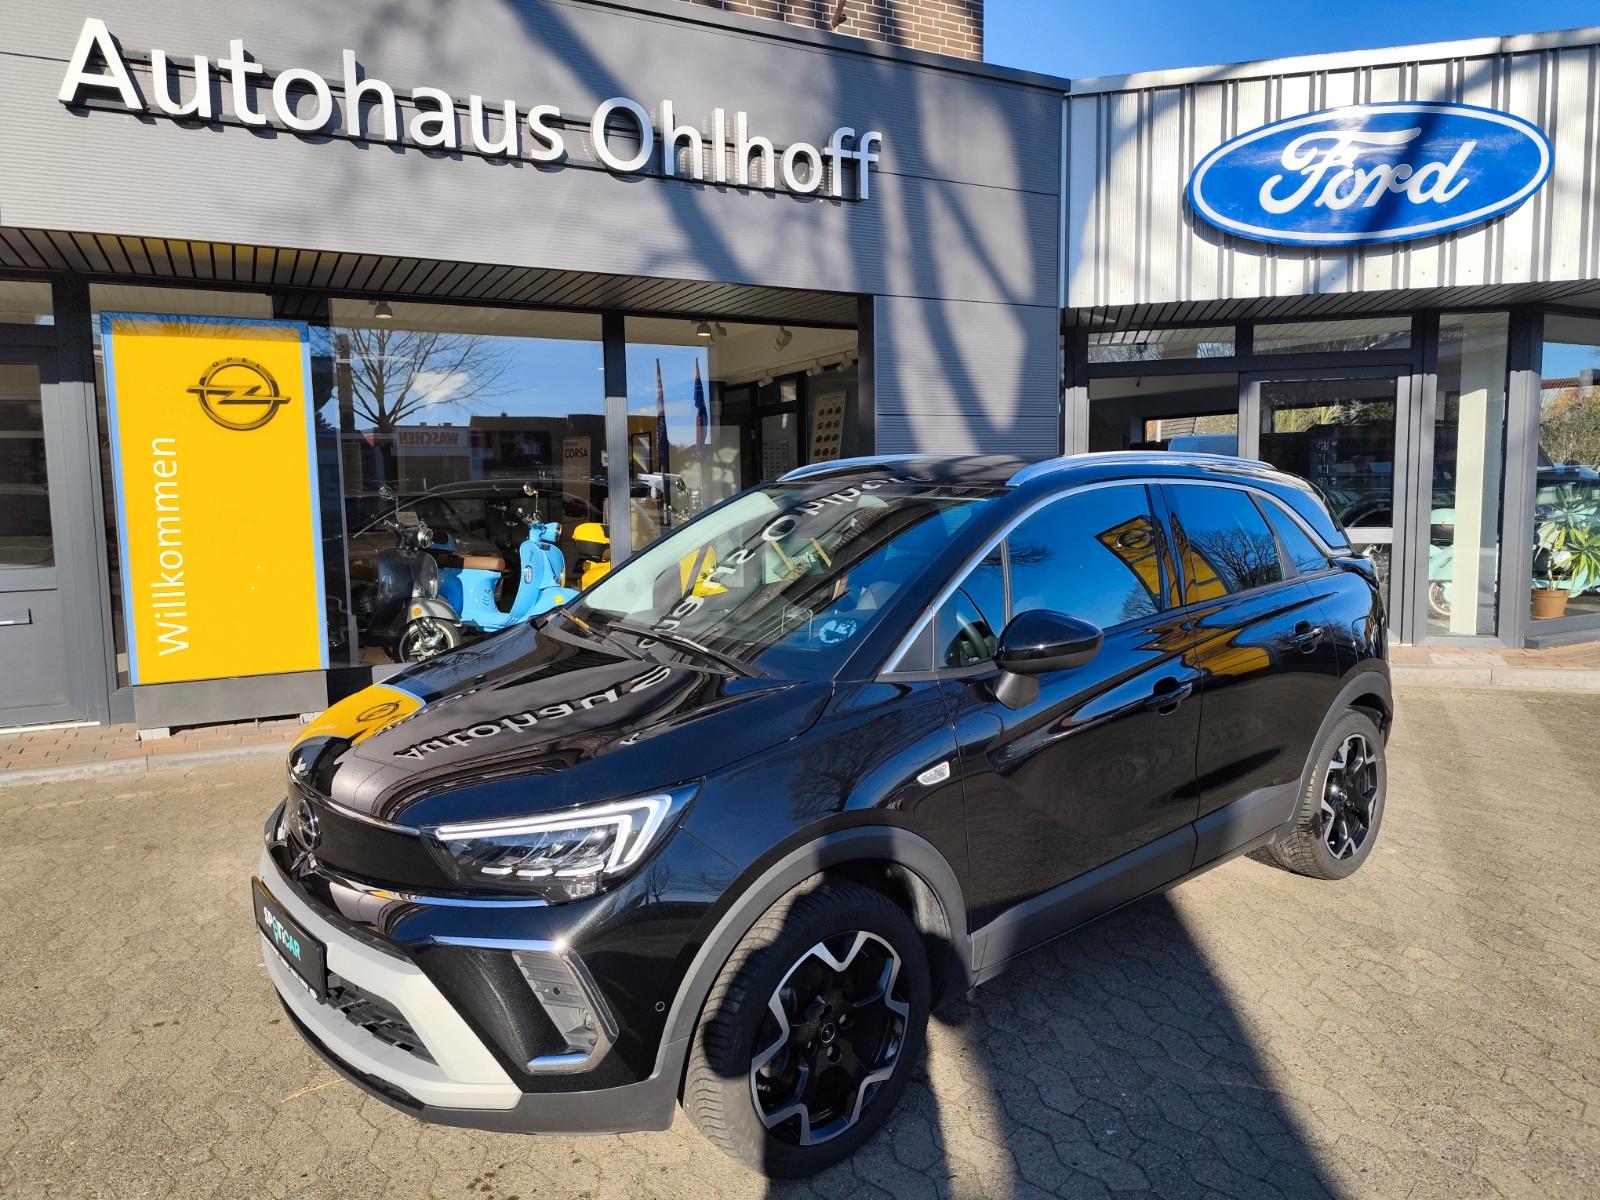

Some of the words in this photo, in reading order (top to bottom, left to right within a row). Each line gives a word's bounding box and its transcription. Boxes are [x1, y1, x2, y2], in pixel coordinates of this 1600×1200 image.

[58, 17, 565, 162] Autohaus
[591, 97, 883, 200] Ohlhoff
[1259, 127, 1477, 215] Ford
[212, 356, 262, 370] OPEL
[564, 447, 589, 458] CORSA
[150, 437, 190, 658] Willkommen
